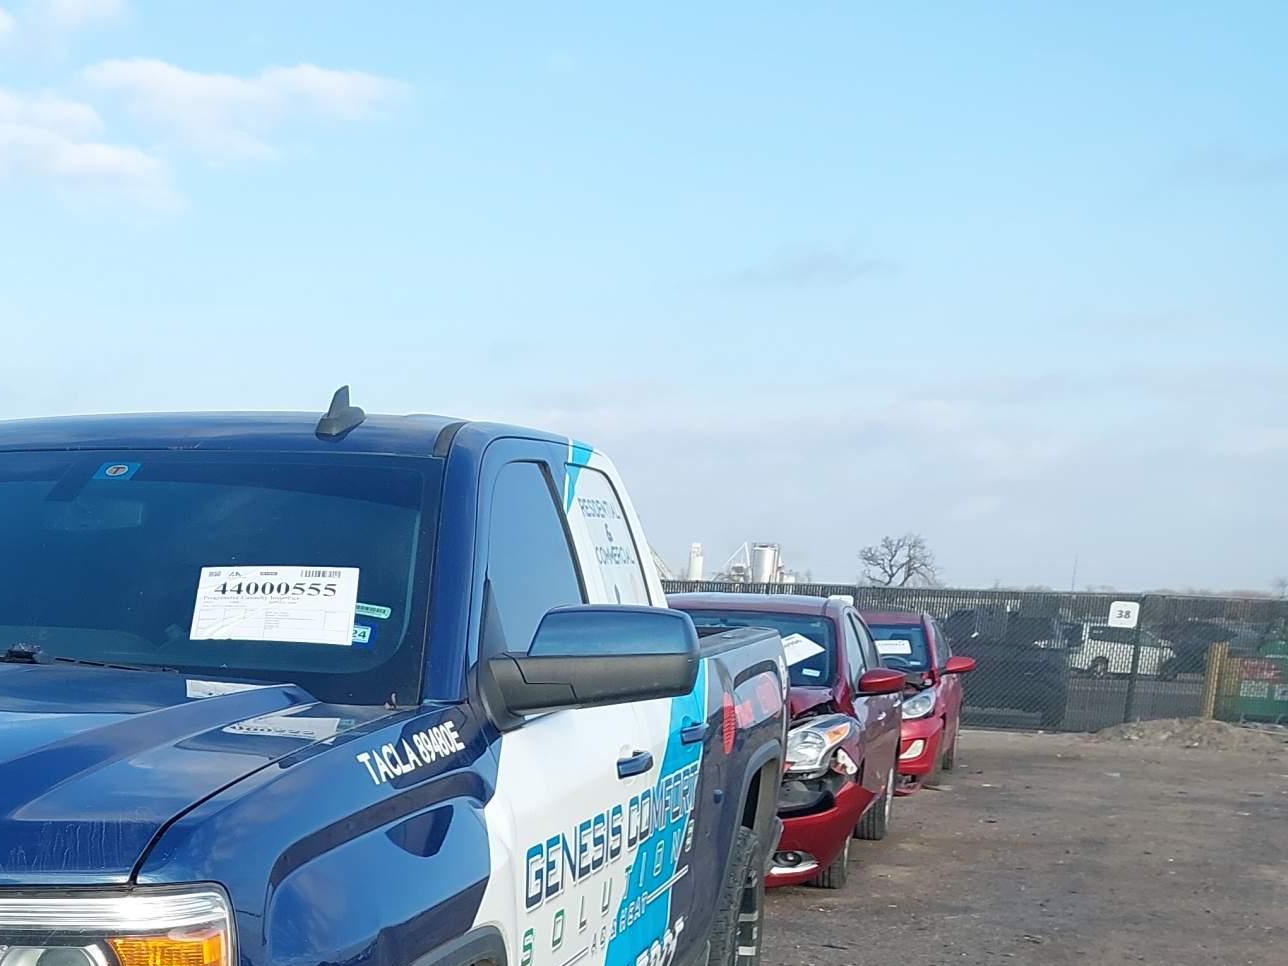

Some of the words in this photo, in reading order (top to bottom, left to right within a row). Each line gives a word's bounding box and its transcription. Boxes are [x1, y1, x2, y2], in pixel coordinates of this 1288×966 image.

[213, 581, 338, 598] 44000555
[1116, 609, 1131, 619] 38
[356, 738, 423, 785] TACLA
[525, 804, 623, 914] GENESIS
[626, 762, 700, 852] COMFORT
[618, 891, 649, 934] HEAT
